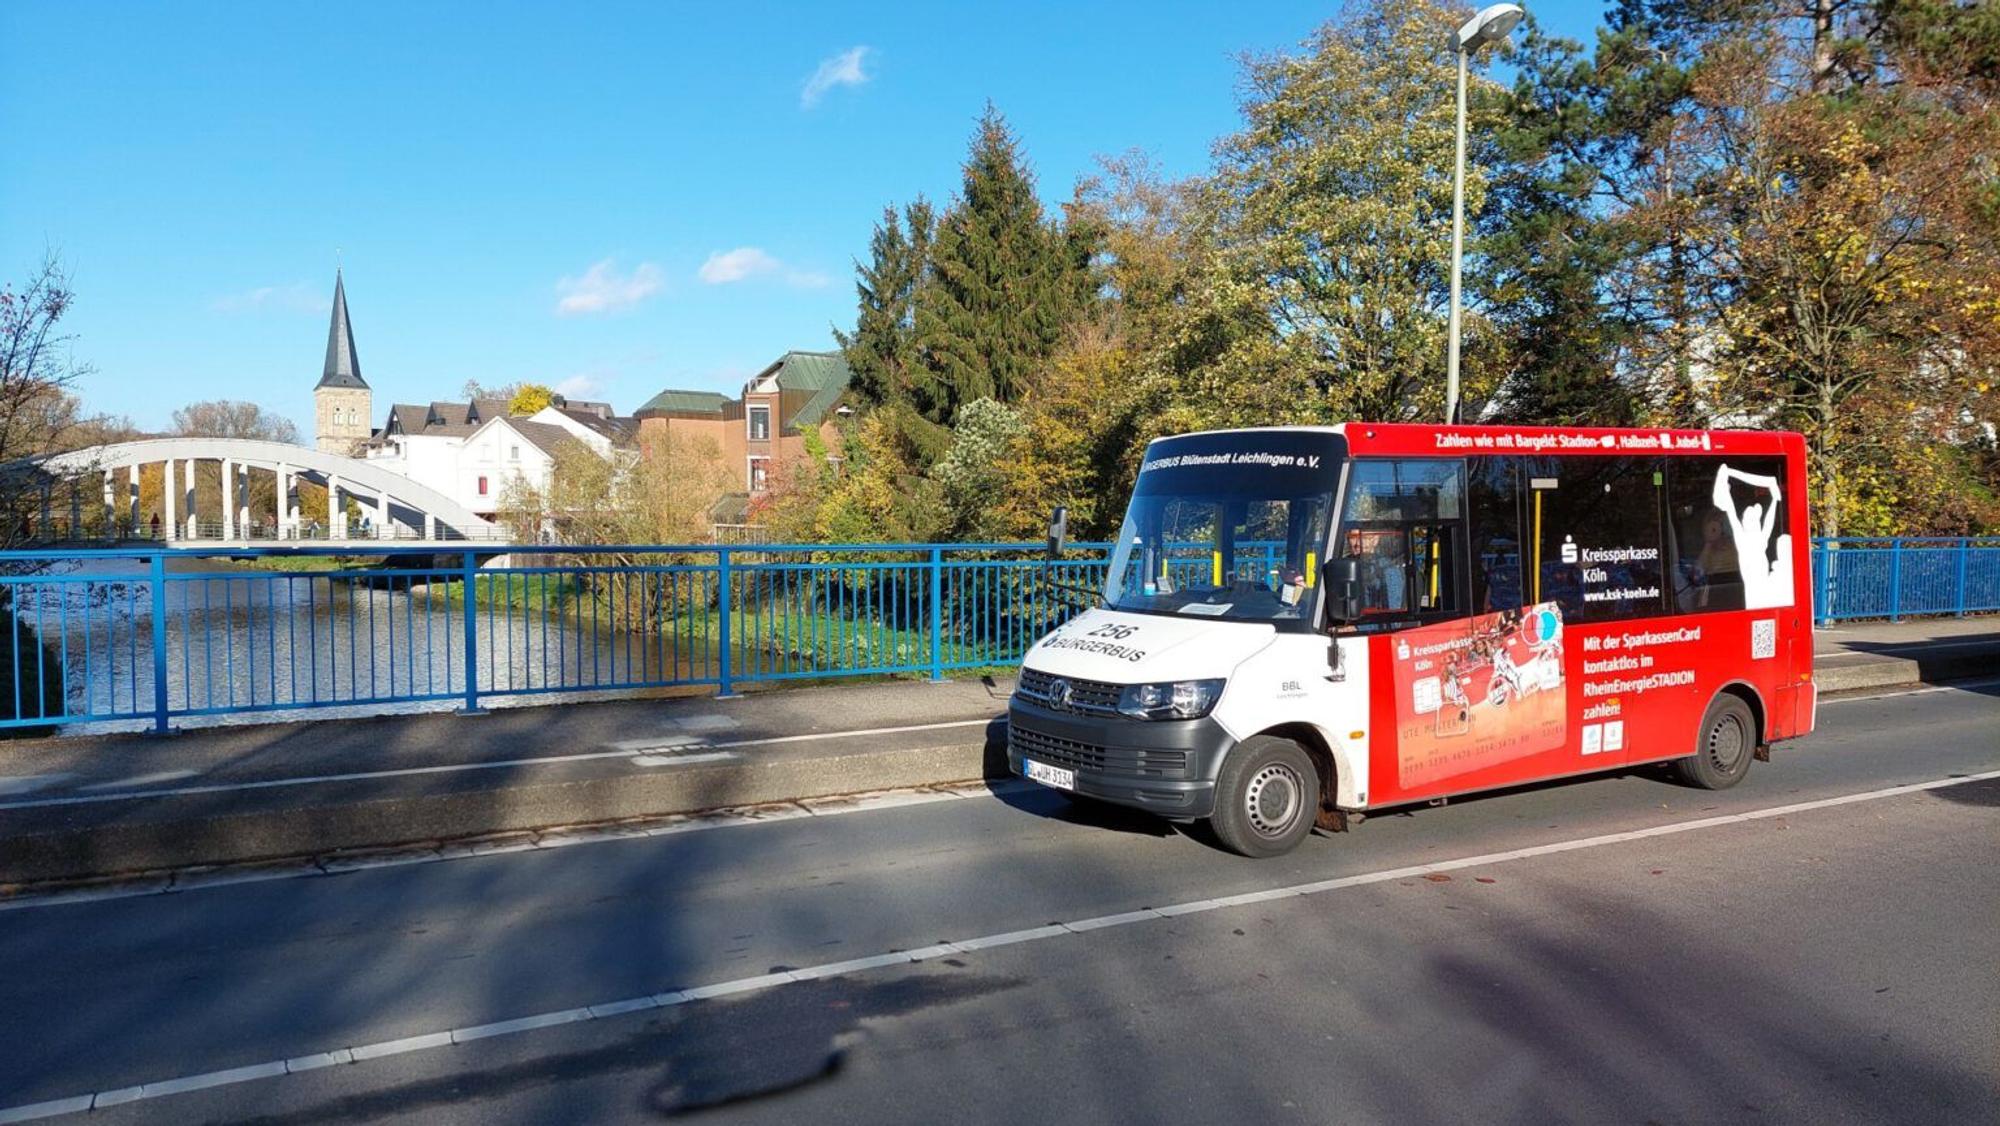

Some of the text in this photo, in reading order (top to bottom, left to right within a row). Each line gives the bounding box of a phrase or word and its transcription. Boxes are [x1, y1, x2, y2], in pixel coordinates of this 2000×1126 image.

[1435, 433, 1473, 448] Zahlen
[1474, 434, 1494, 448] wie
[1495, 434, 1514, 448] mit
[1514, 434, 1557, 451] Bargeld:
[1231, 452, 1294, 467] Leichlingen
[1296, 456, 1320, 469] e.V.
[1582, 546, 1658, 564] Kreissparkasse
[1583, 568, 1607, 583] Köln
[1584, 586, 1660, 601] www.ksk-koeln.de
[1088, 623, 1140, 640] 256
[1583, 626, 1701, 651] Mit der SparkassenCard
[1583, 653, 1653, 674] kontaktlos im
[1583, 670, 1695, 697] RheinEnergieSTADION
